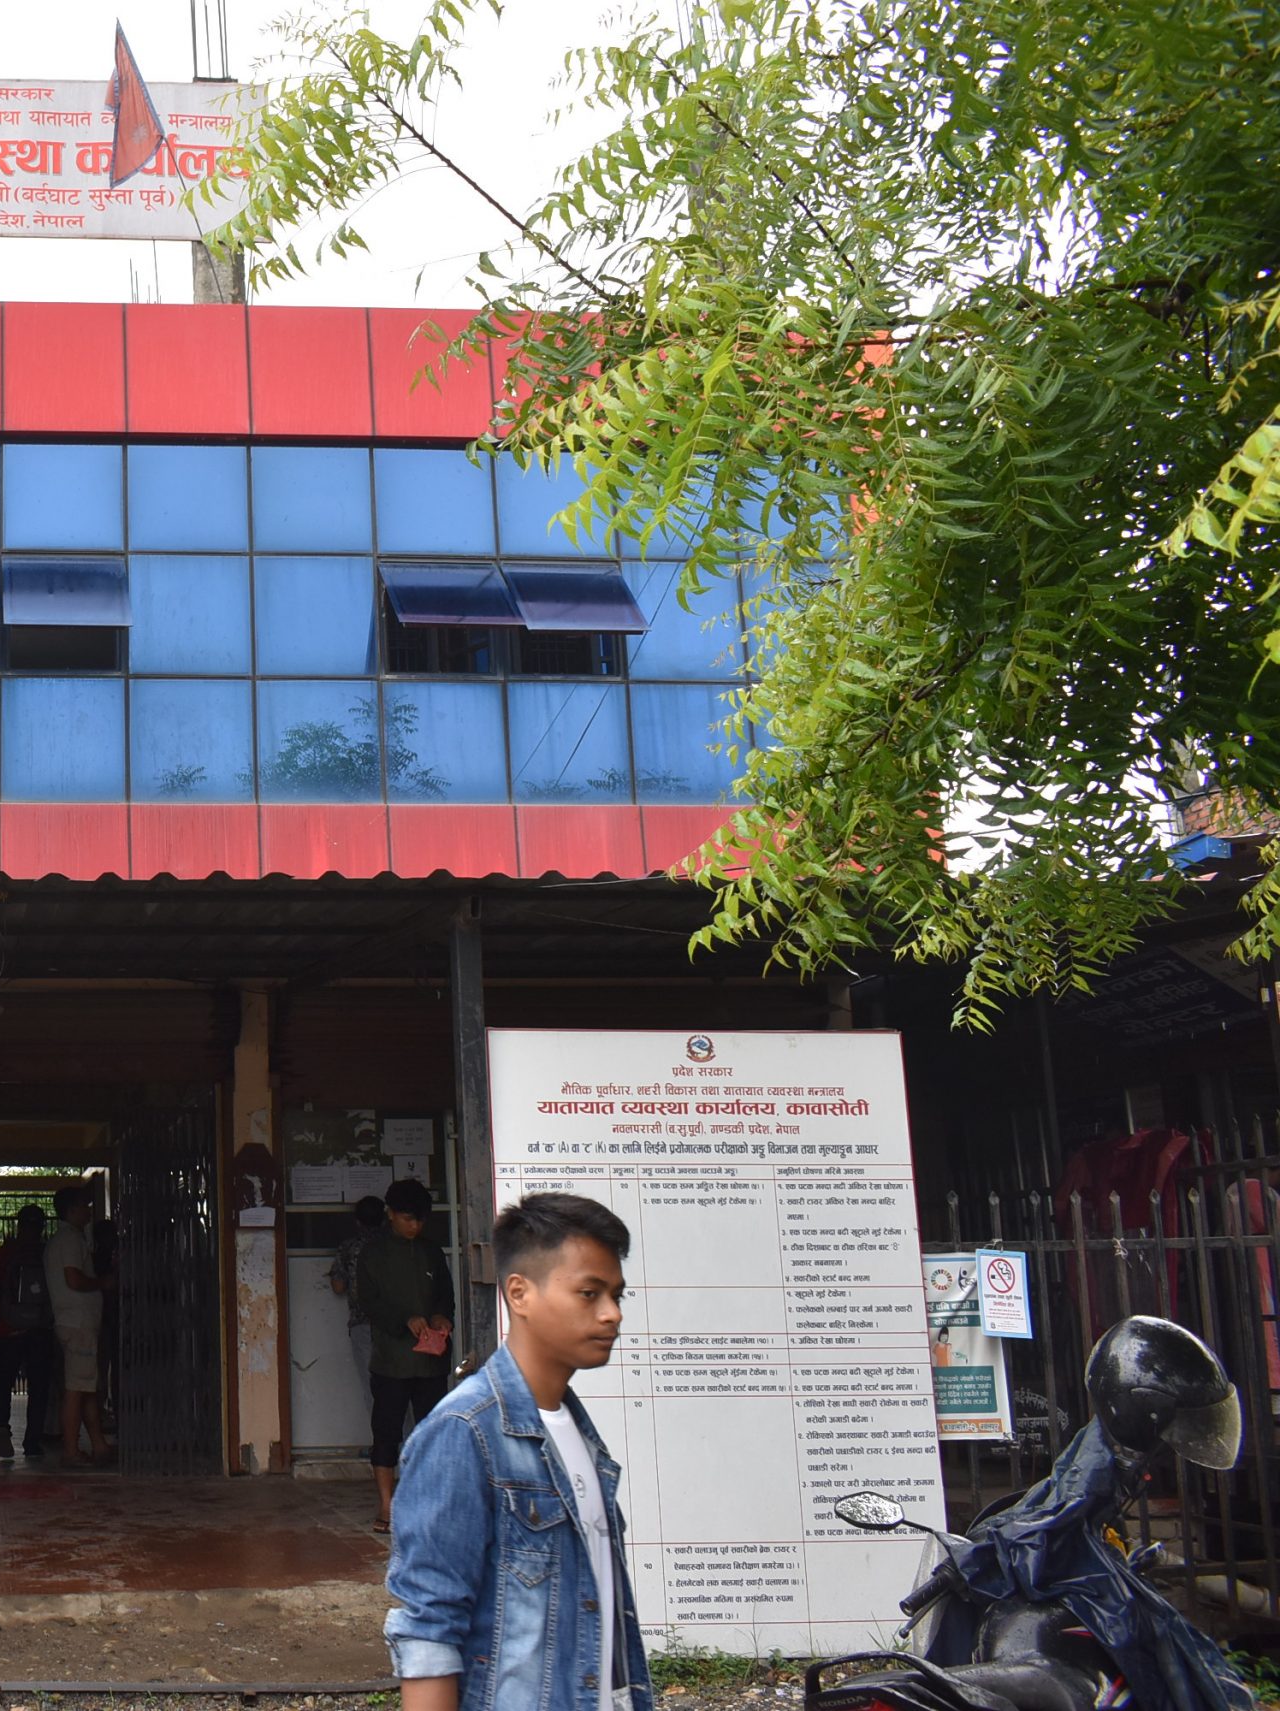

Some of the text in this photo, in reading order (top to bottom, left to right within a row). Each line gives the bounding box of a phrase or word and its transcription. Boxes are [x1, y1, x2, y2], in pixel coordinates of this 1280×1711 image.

[29, 110, 92, 127] यातायात
[89, 188, 133, 210] सुस्ता
[33, 210, 85, 228] नेपाल
[672, 1064, 733, 1077] प्रदेश सरकार
[561, 1082, 592, 1095] भौतिक
[637, 1083, 660, 1096] शहरी
[665, 1083, 696, 1096] विकास
[701, 1086, 719, 1096] तथा
[723, 1086, 764, 1096] यातायात
[767, 1087, 804, 1097] व्यवस्था
[807, 1087, 845, 1097] मन्त्रालय
[537, 1101, 615, 1115] यातायात
[621, 1101, 689, 1116] व्यवस्था
[786, 1099, 869, 1116] कावासोती
[612, 1121, 662, 1135] नवलपरासी
[710, 1122, 744, 1134] गण्डकी
[776, 1122, 800, 1134] नेपाल
[528, 1141, 540, 1153] वर्ग
[571, 1143, 580, 1153] वा
[609, 1143, 619, 1153] का
[622, 1141, 642, 1154] लागि
[669, 1142, 712, 1155] प्रयोगात्मक
[714, 1142, 748, 1155] परीक्षाको
[801, 1144, 816, 1155] तथा
[855, 1144, 879, 1155] आधार
